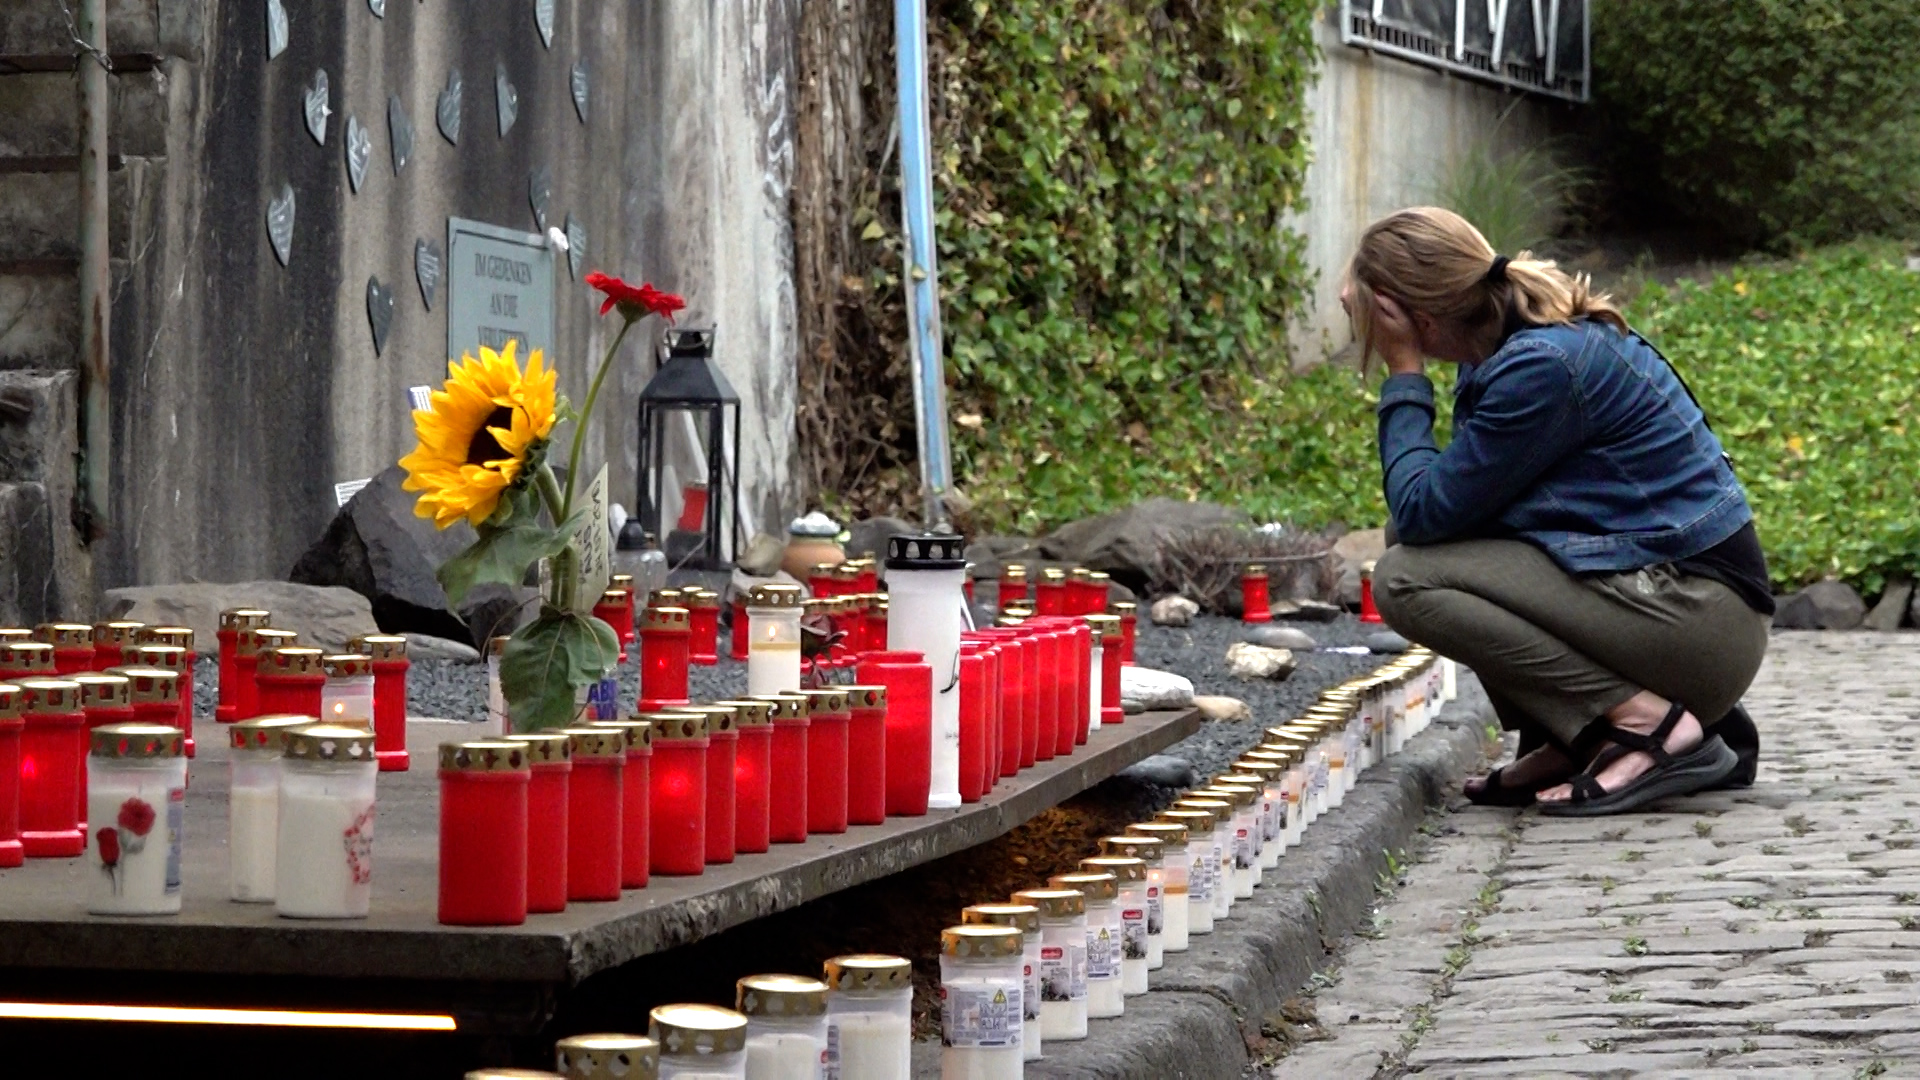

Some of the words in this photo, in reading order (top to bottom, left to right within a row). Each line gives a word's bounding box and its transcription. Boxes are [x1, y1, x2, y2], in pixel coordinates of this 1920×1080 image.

[475, 252, 486, 277] IM
[487, 255, 532, 285] GEDENKEN
[489, 293, 502, 316] AN
